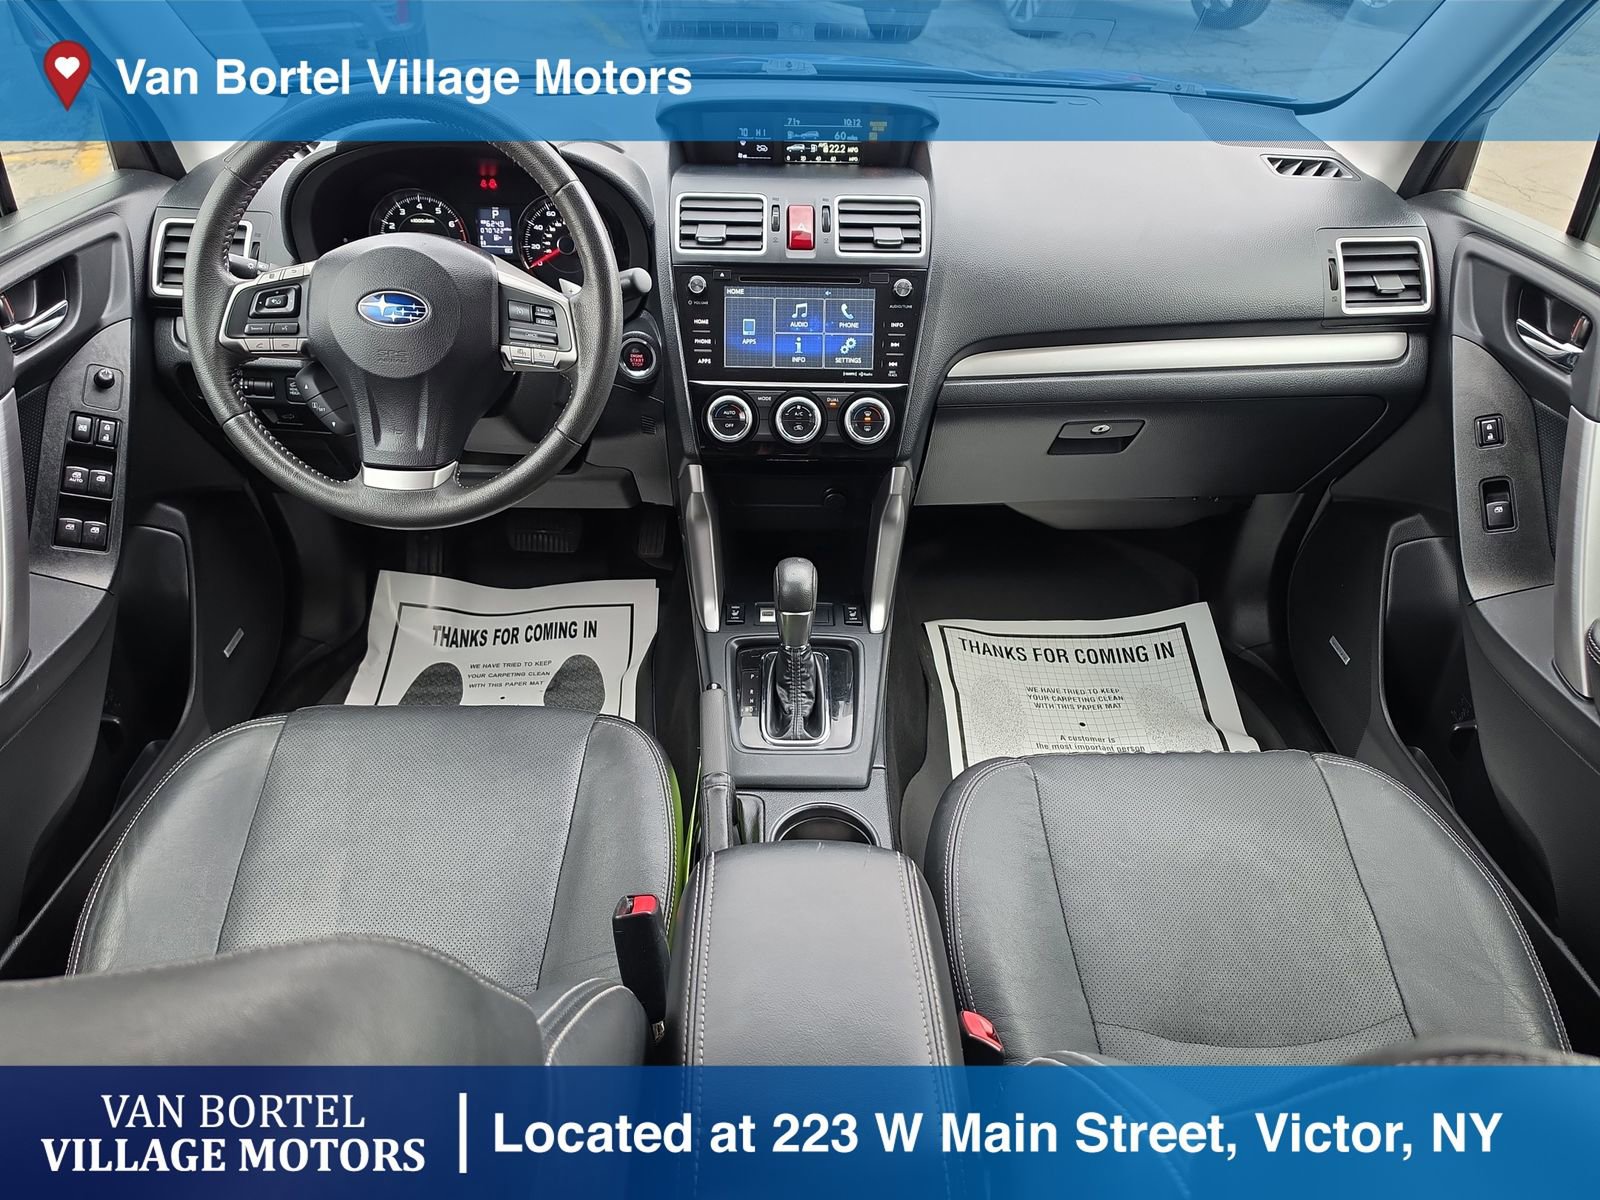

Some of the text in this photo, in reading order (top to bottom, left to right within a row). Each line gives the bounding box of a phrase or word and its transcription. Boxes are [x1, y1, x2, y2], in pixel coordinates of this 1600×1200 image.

[834, 132, 846, 140] 60
[829, 144, 846, 153] 22.2
[388, 222, 396, 230] 2
[400, 208, 406, 216] 3
[435, 207, 442, 215] 5
[448, 220, 456, 228] 6
[492, 210, 500, 220] P
[432, 620, 598, 648] THANKS FOR COMING IN
[958, 637, 1176, 666] THANKS FOR COMING IN
[1068, 735, 1106, 743] customer
[1074, 744, 1114, 752] important
